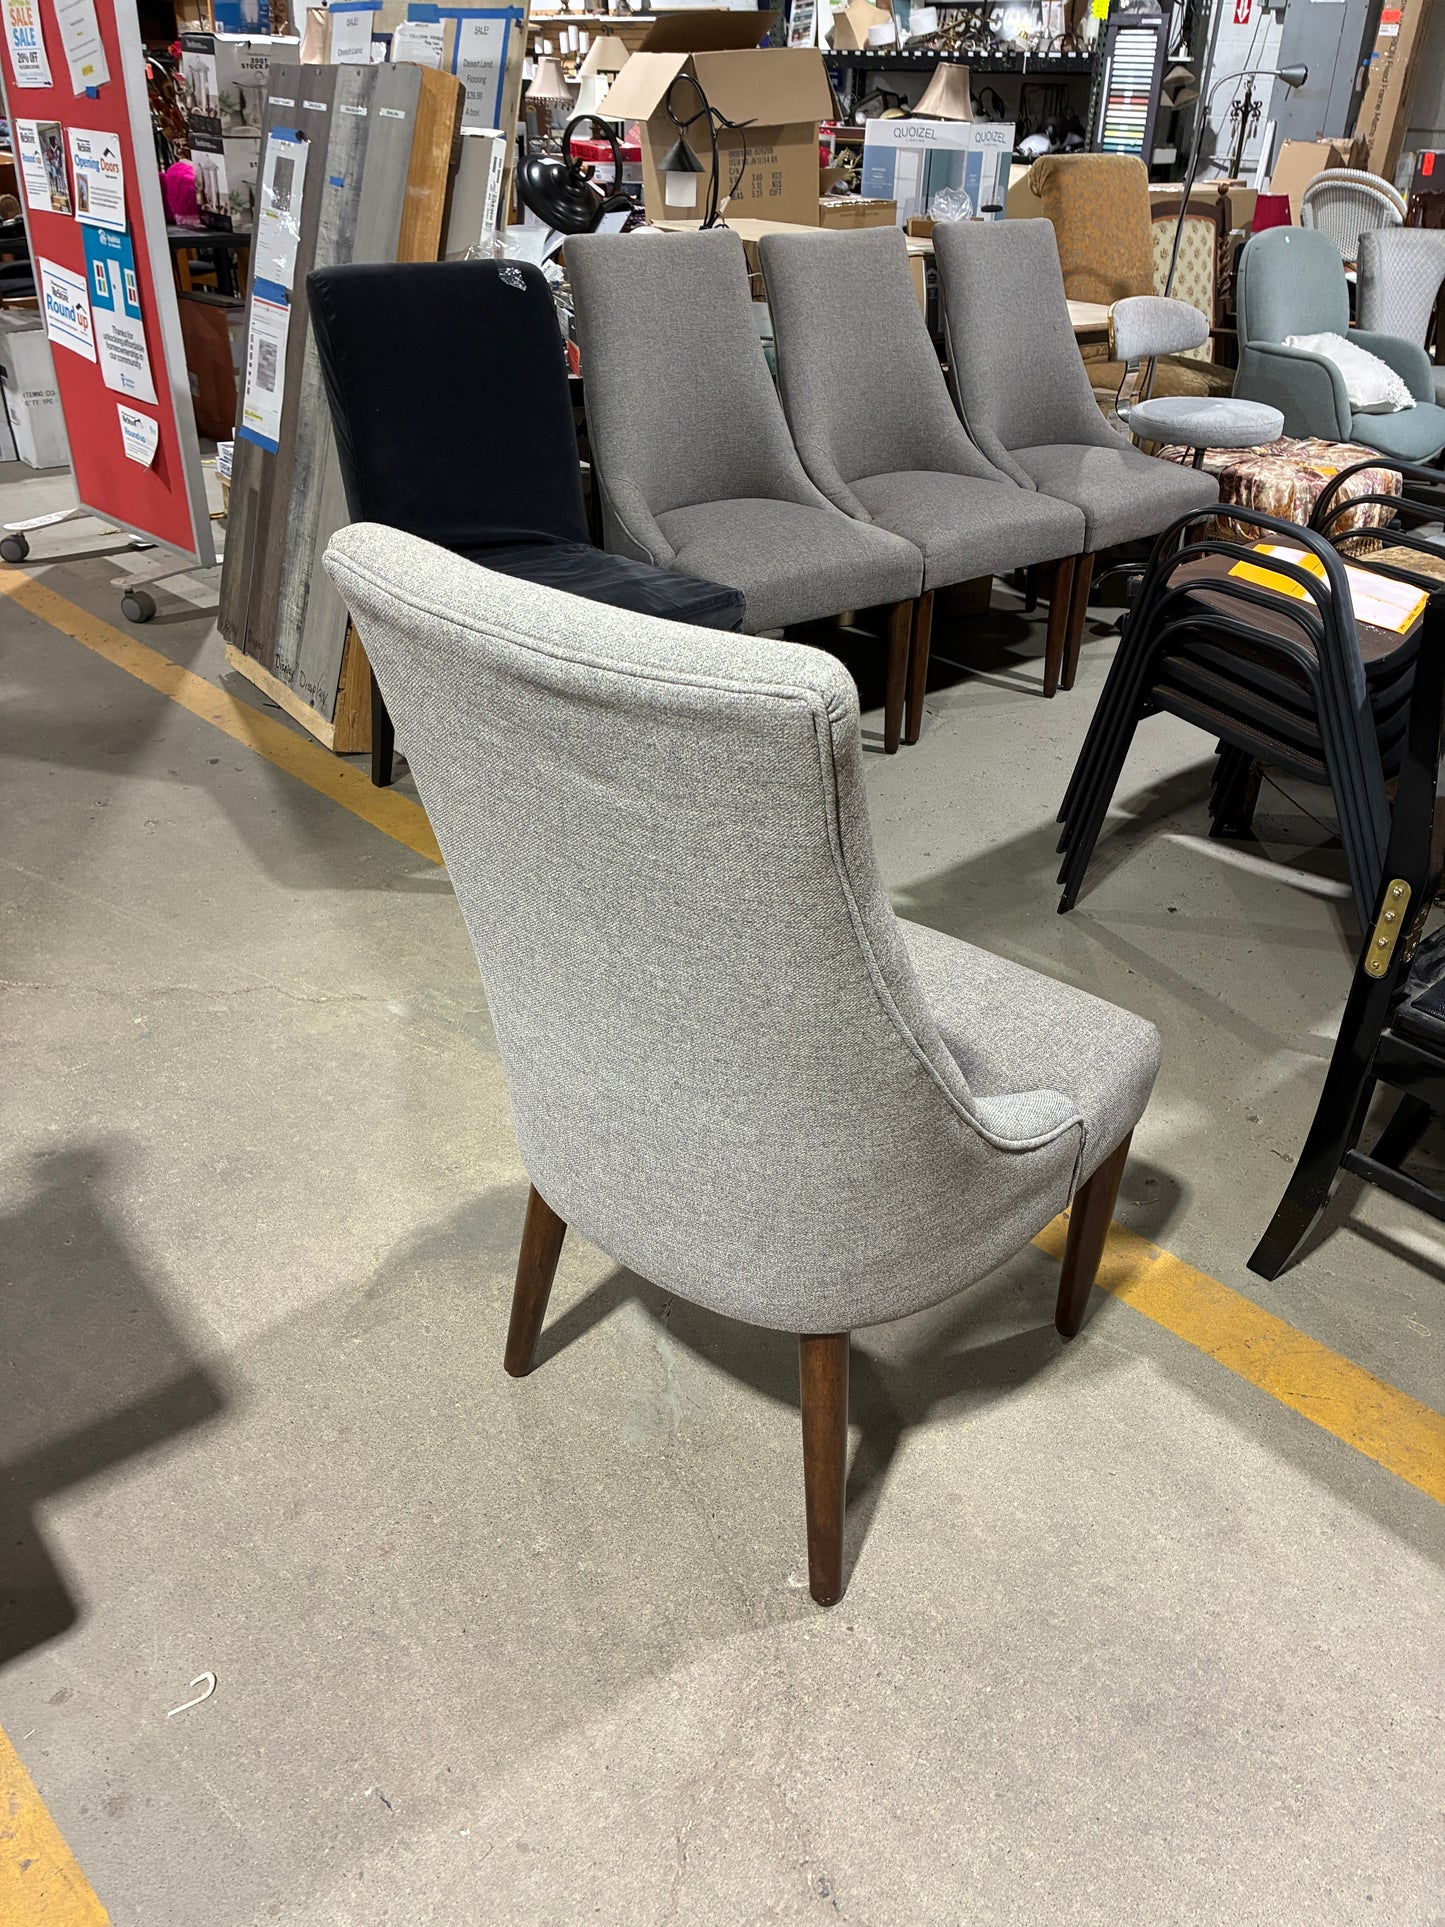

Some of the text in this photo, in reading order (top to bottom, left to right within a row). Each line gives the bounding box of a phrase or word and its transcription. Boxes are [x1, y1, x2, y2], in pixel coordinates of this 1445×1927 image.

[10, 8, 33, 27] SALE
[13, 28, 36, 46] SALE
[29, 51, 39, 63] OFF
[893, 127, 937, 141] QUOIZEL
[974, 131, 1007, 145] QUOIZEL
[74, 154, 120, 173] Opening Doors
[46, 293, 76, 322] Round
[77, 312, 89, 331] up
[299, 670, 328, 704] Display
